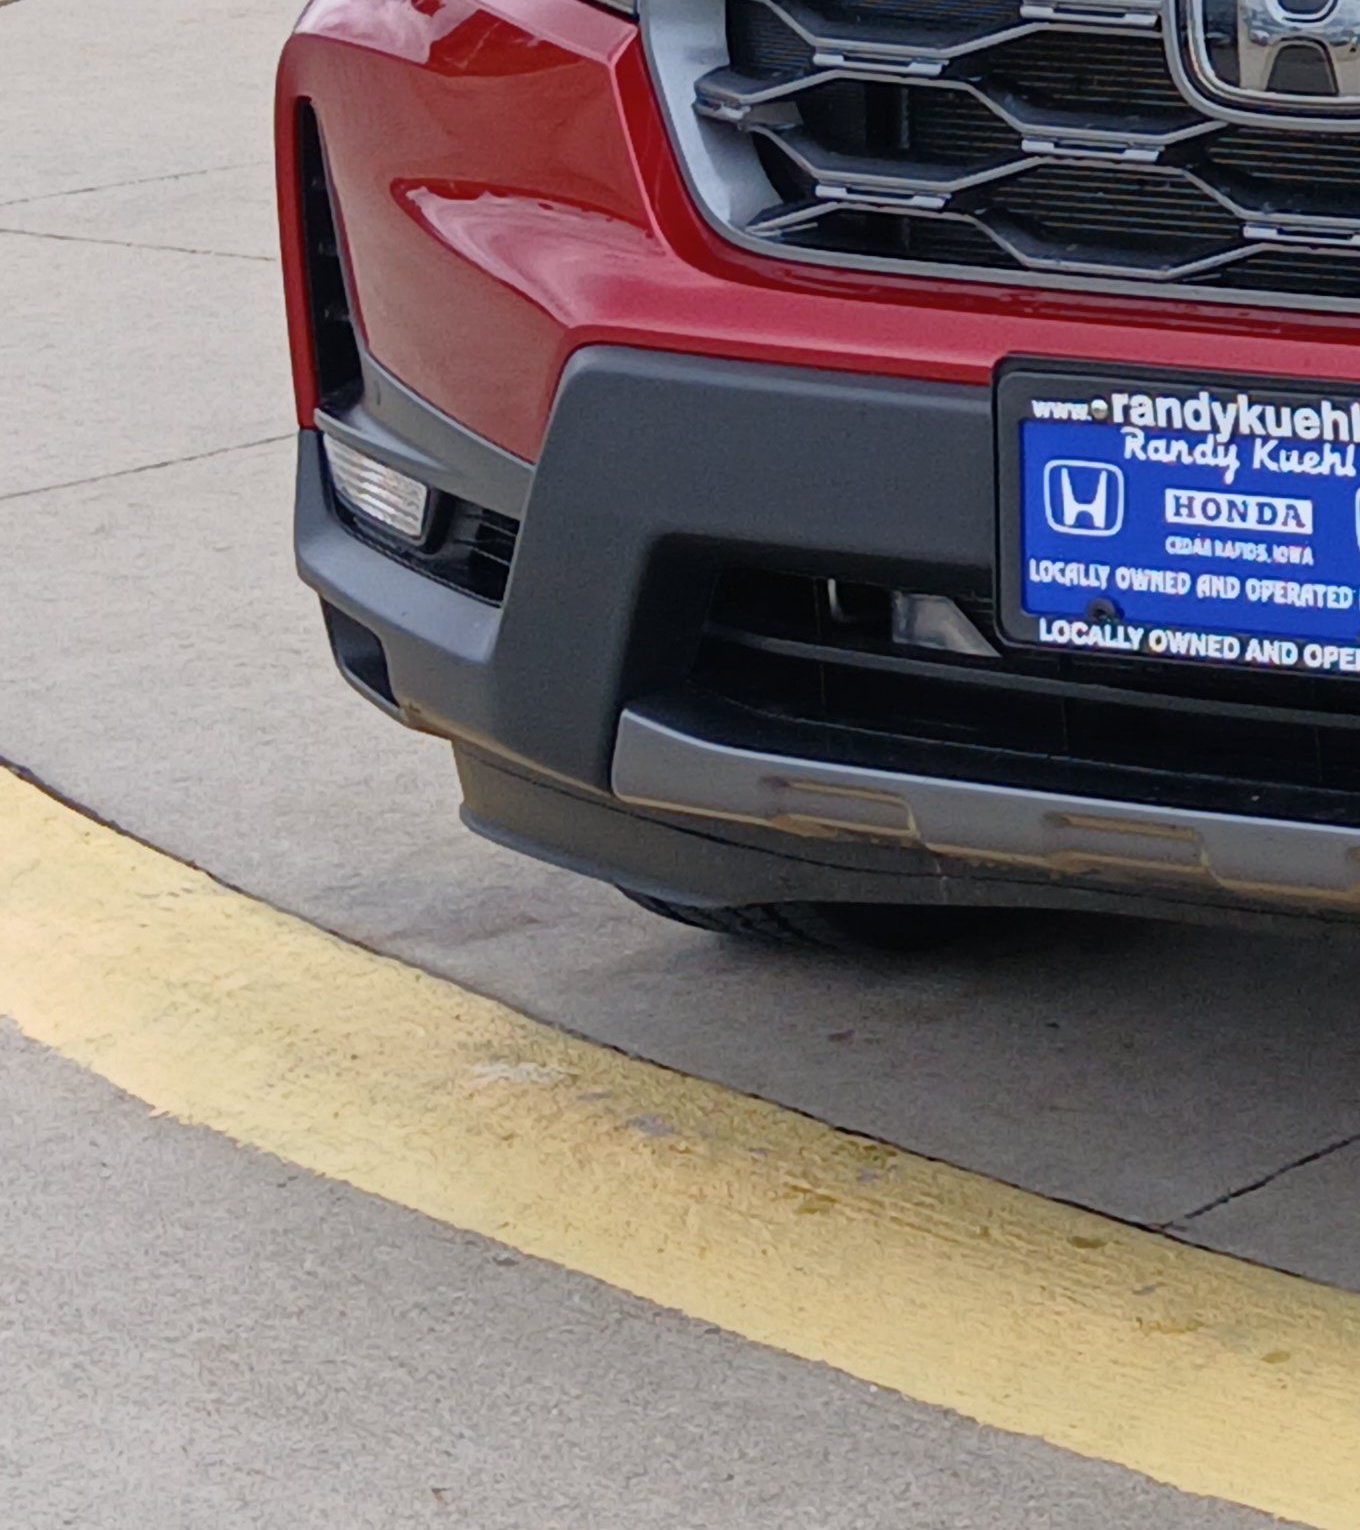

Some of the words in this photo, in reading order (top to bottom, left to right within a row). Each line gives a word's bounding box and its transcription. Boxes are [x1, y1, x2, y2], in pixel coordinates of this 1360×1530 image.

[1120, 426, 1240, 485] Randy
[1252, 437, 1357, 477] Kuehl
[1172, 494, 1307, 529] HONDA
[1272, 544, 1315, 566] IOWA
[1029, 558, 1110, 590] LOCALLY
[1115, 566, 1191, 595] OWNED
[1196, 573, 1240, 599] AND
[1245, 578, 1354, 610] OPERATED
[1039, 617, 1144, 651] LOCALLY
[1148, 629, 1241, 660] OWNED
[1245, 638, 1299, 666] AND
